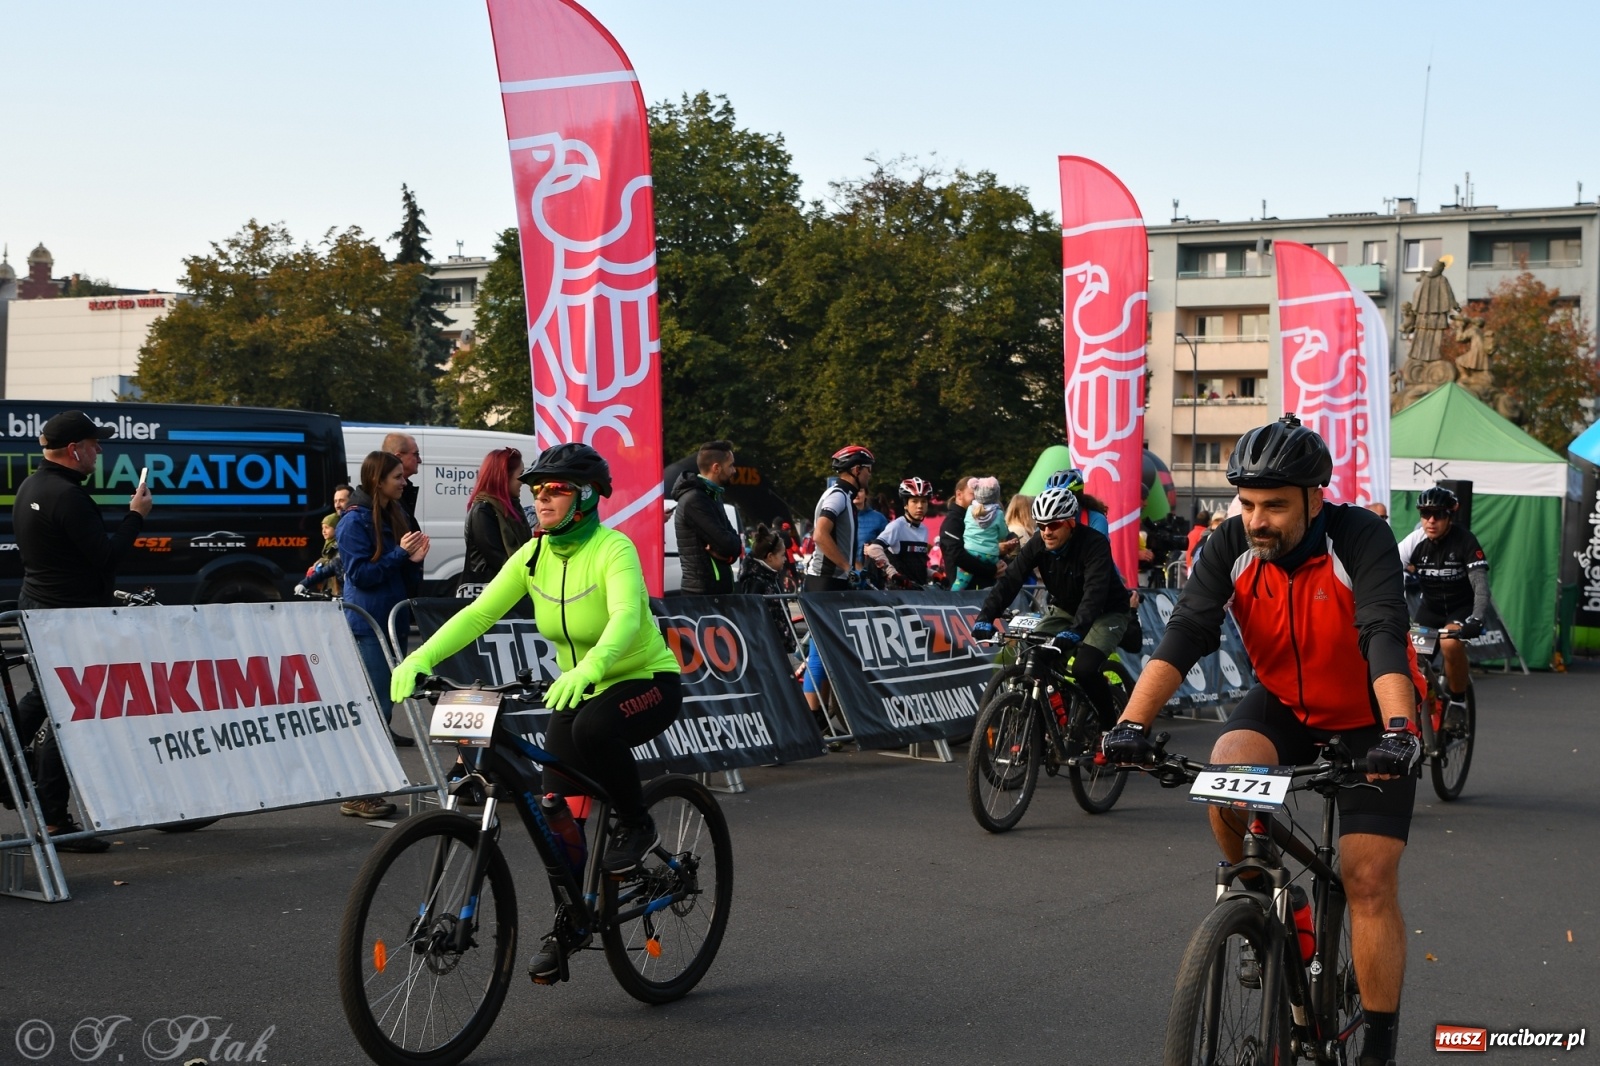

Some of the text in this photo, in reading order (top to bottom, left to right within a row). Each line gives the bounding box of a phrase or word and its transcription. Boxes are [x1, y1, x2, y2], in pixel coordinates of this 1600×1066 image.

[8, 412, 161, 440] bik telier
[133, 537, 172, 547] CST
[257, 537, 308, 547] MAXXIS
[1470, 630, 1505, 646] ERIDA
[619, 686, 663, 718] SCRAPPER
[881, 685, 979, 728] USZCZELNIAMY
[443, 711, 485, 729] 3238
[149, 725, 211, 764] TAKE
[210, 716, 276, 753] MORE
[665, 711, 774, 757] NAJLEPSZYCH
[1211, 777, 1272, 796] 3171
